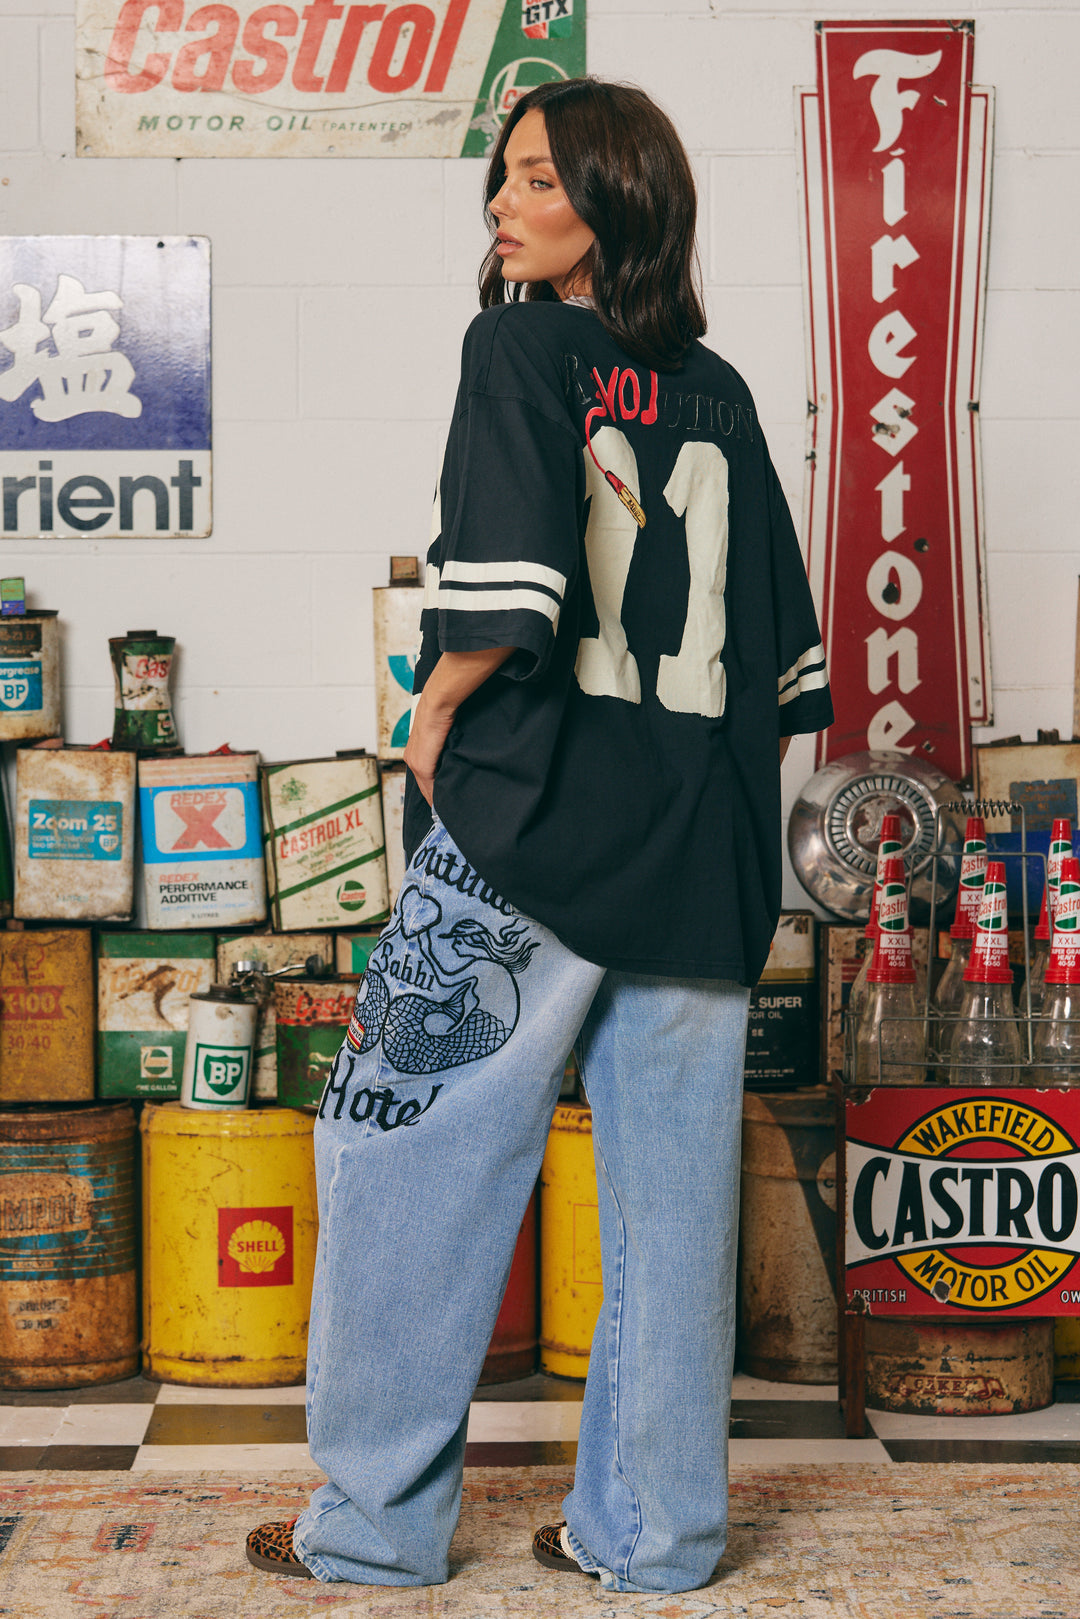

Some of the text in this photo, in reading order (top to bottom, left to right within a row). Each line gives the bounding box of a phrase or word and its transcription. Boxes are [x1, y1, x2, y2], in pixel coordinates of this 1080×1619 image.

[526, 0, 568, 25] GTX
[103, 0, 473, 94] Castrol
[137, 115, 245, 132] MOTOR
[266, 115, 313, 132] OIL
[853, 49, 942, 756] Firestone
[4, 684, 26, 700] BP
[170, 791, 228, 806] REDEX
[33, 812, 117, 832] Zoom 25
[280, 817, 343, 859] CASTROL
[344, 808, 363, 832] XL
[159, 872, 200, 884] REDEX
[159, 880, 249, 894] PERFORMANCE
[160, 892, 217, 905] ADDITIVE
[887, 937, 906, 946] XXL
[983, 937, 1002, 946] XXL
[1057, 937, 1077, 946] XXL
[758, 996, 803, 1009] SUPER
[767, 1011, 783, 1020] OIL
[208, 1062, 242, 1086] BP
[911, 1104, 1055, 1153] WAKEFIELD
[236, 1240, 279, 1253] SHELL
[914, 1252, 1059, 1302] MOTOR OIL
